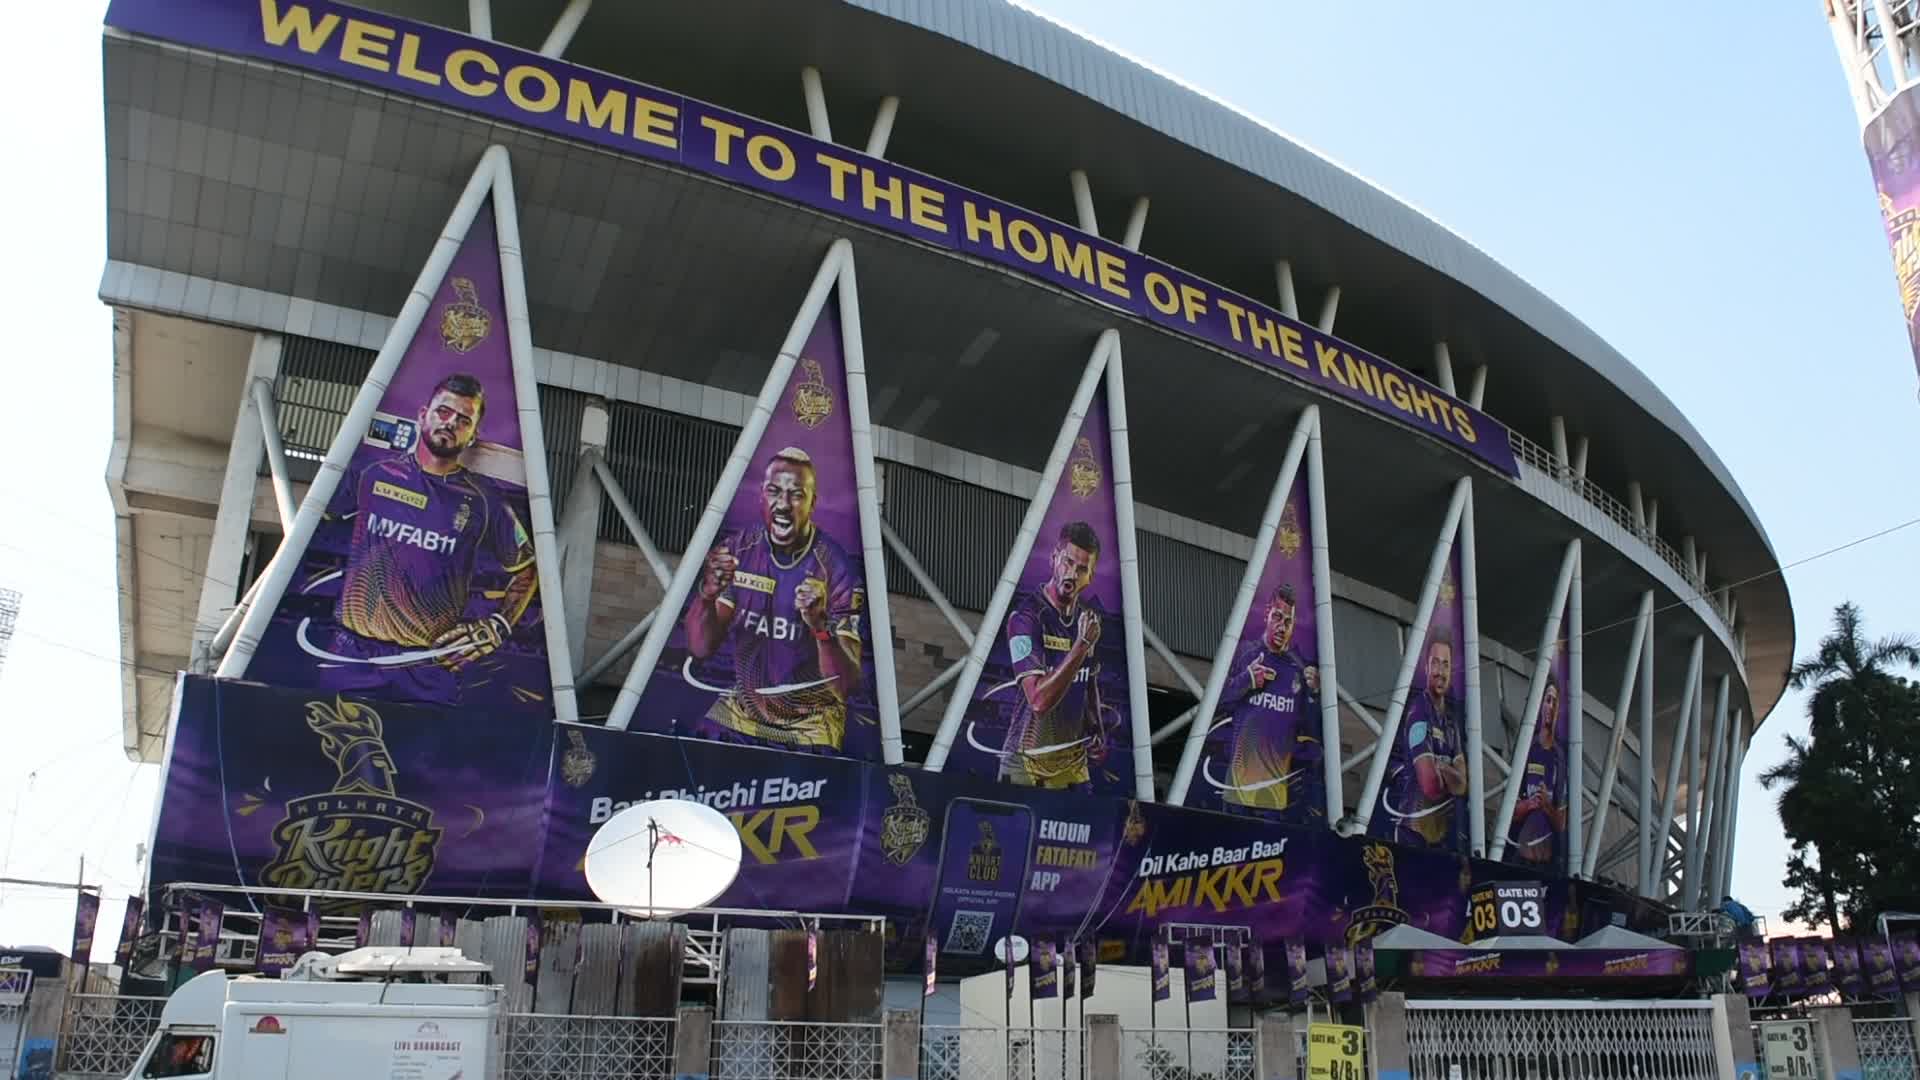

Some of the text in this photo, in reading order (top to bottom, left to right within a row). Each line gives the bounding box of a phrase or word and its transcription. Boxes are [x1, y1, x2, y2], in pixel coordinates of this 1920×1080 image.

[260, 0, 1478, 444] WELCOME TO THE HOME OF THE KNIGHTS
[761, 778, 827, 804] Ebar
[281, 815, 433, 873] Knight
[1039, 819, 1091, 844] EKDUM
[1036, 846, 1097, 870] FATAFATI
[1139, 838, 1288, 877] Dil Kahe Baar Baar
[1030, 871, 1060, 891] APP
[1498, 888, 1538, 898] GATE NO
[1474, 903, 1496, 932] 03
[1502, 901, 1541, 928] 03
[1342, 1030, 1359, 1056] 3
[1792, 1026, 1808, 1051] 3
